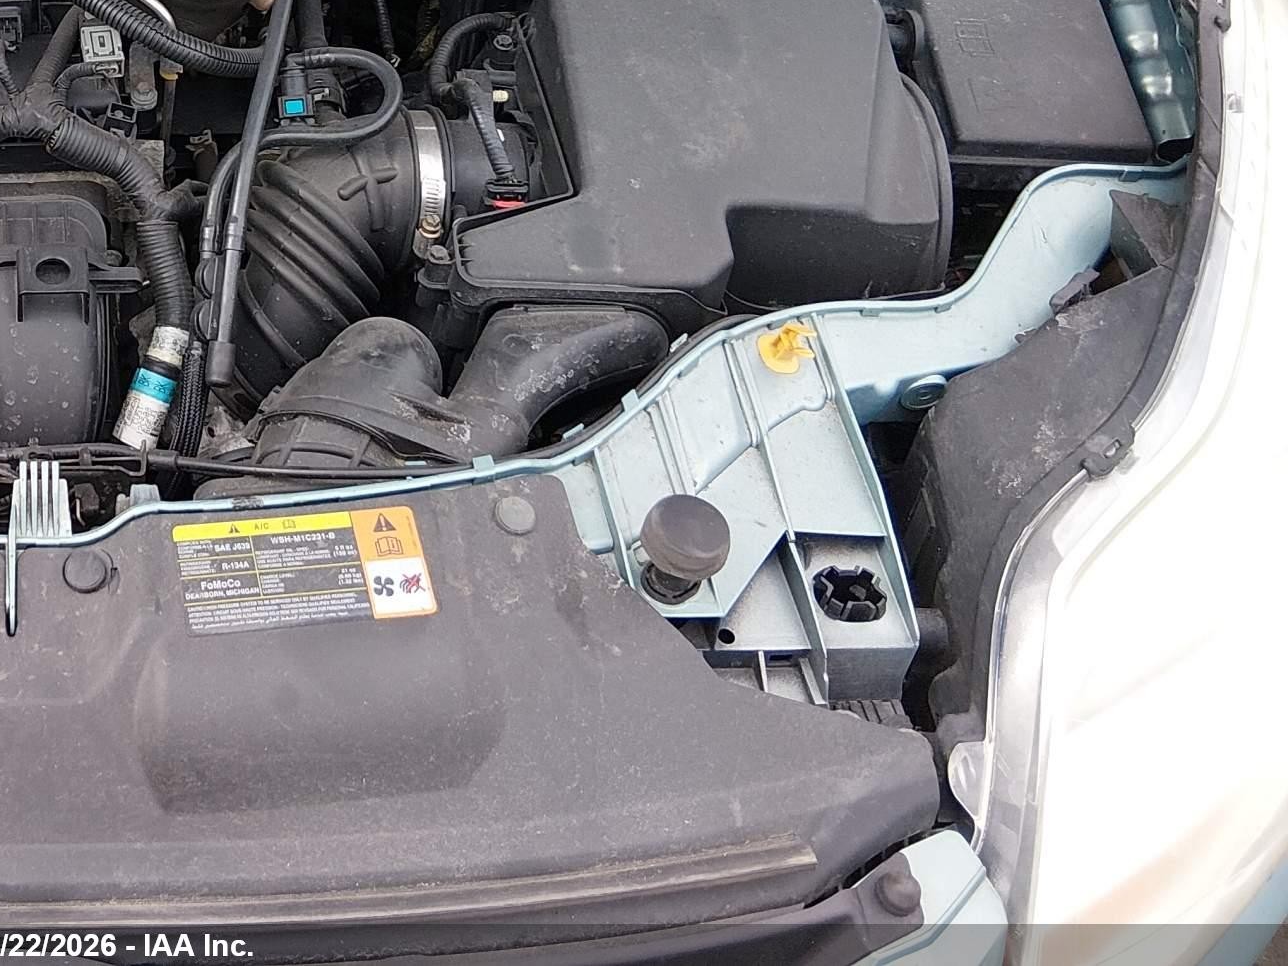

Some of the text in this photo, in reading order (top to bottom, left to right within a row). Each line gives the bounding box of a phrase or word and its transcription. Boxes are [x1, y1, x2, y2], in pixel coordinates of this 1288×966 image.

[254, 523, 270, 531] A/C
[222, 561, 250, 571] R-134A
[200, 579, 241, 590] FoMoCo
[226, 587, 260, 596] MICHIGAN
